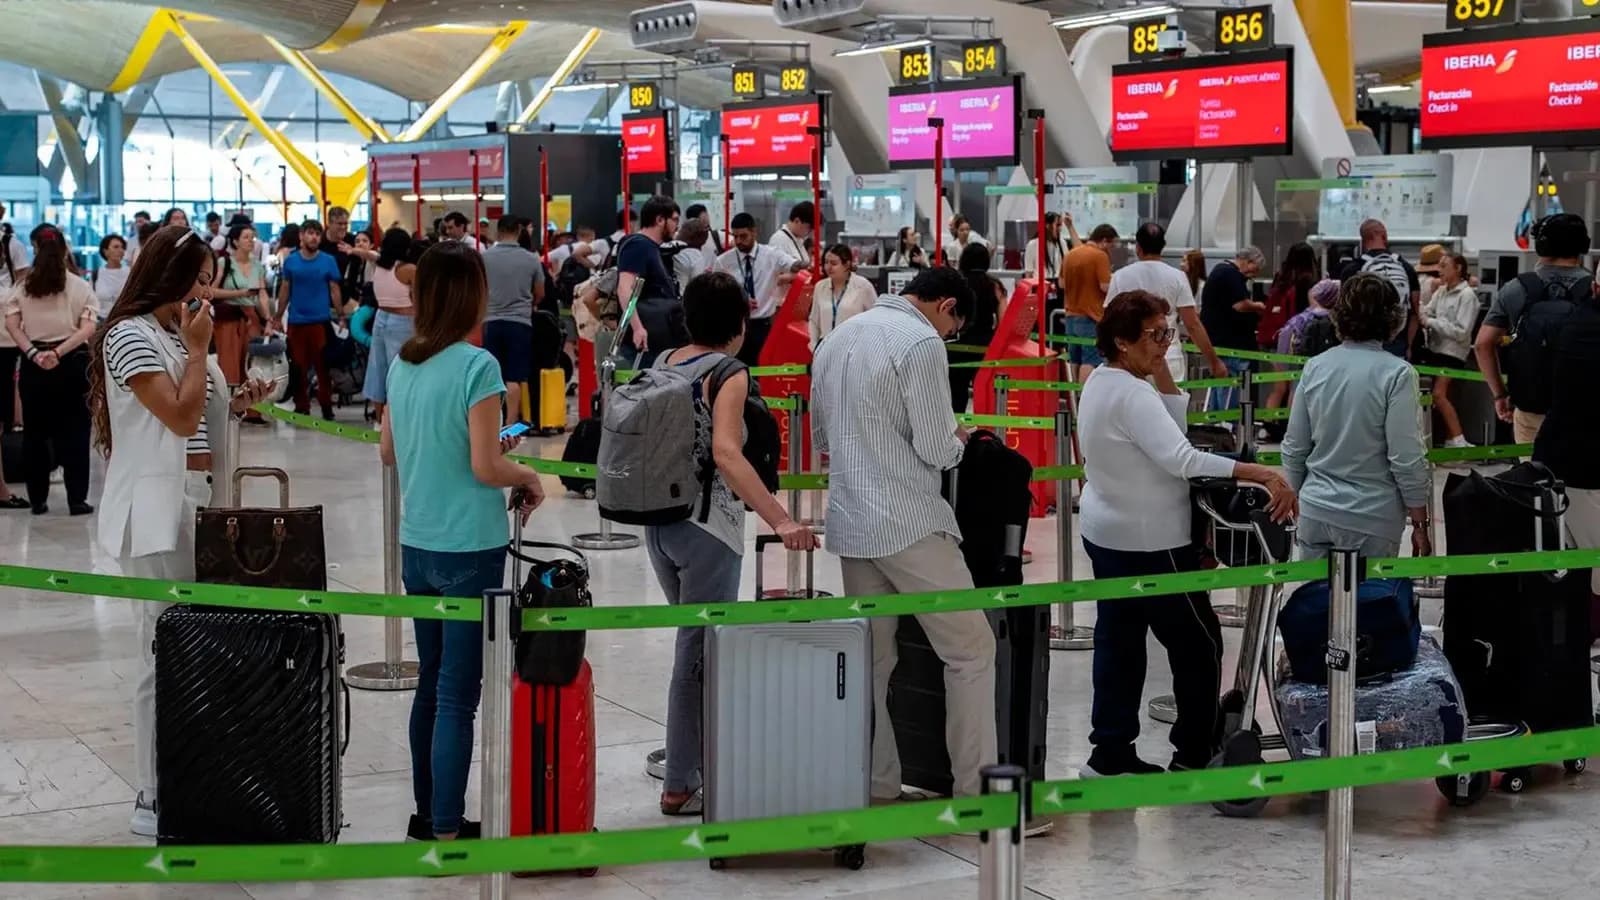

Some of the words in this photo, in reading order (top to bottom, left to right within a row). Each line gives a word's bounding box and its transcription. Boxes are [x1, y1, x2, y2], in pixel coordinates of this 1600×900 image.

[1133, 23, 1168, 53] 85
[1221, 12, 1263, 44] 856
[902, 53, 931, 78] 853
[965, 46, 996, 72] 854
[1444, 55, 1495, 70] IBERIA
[734, 72, 755, 92] 851
[782, 68, 805, 90] 852
[1127, 82, 1163, 96] IBERIA
[1199, 77, 1224, 87] IBERIA
[1549, 80, 1598, 93] Facturación
[631, 87, 652, 107] 850
[960, 97, 989, 109] IBERIA
[1428, 89, 1471, 100] Facturación
